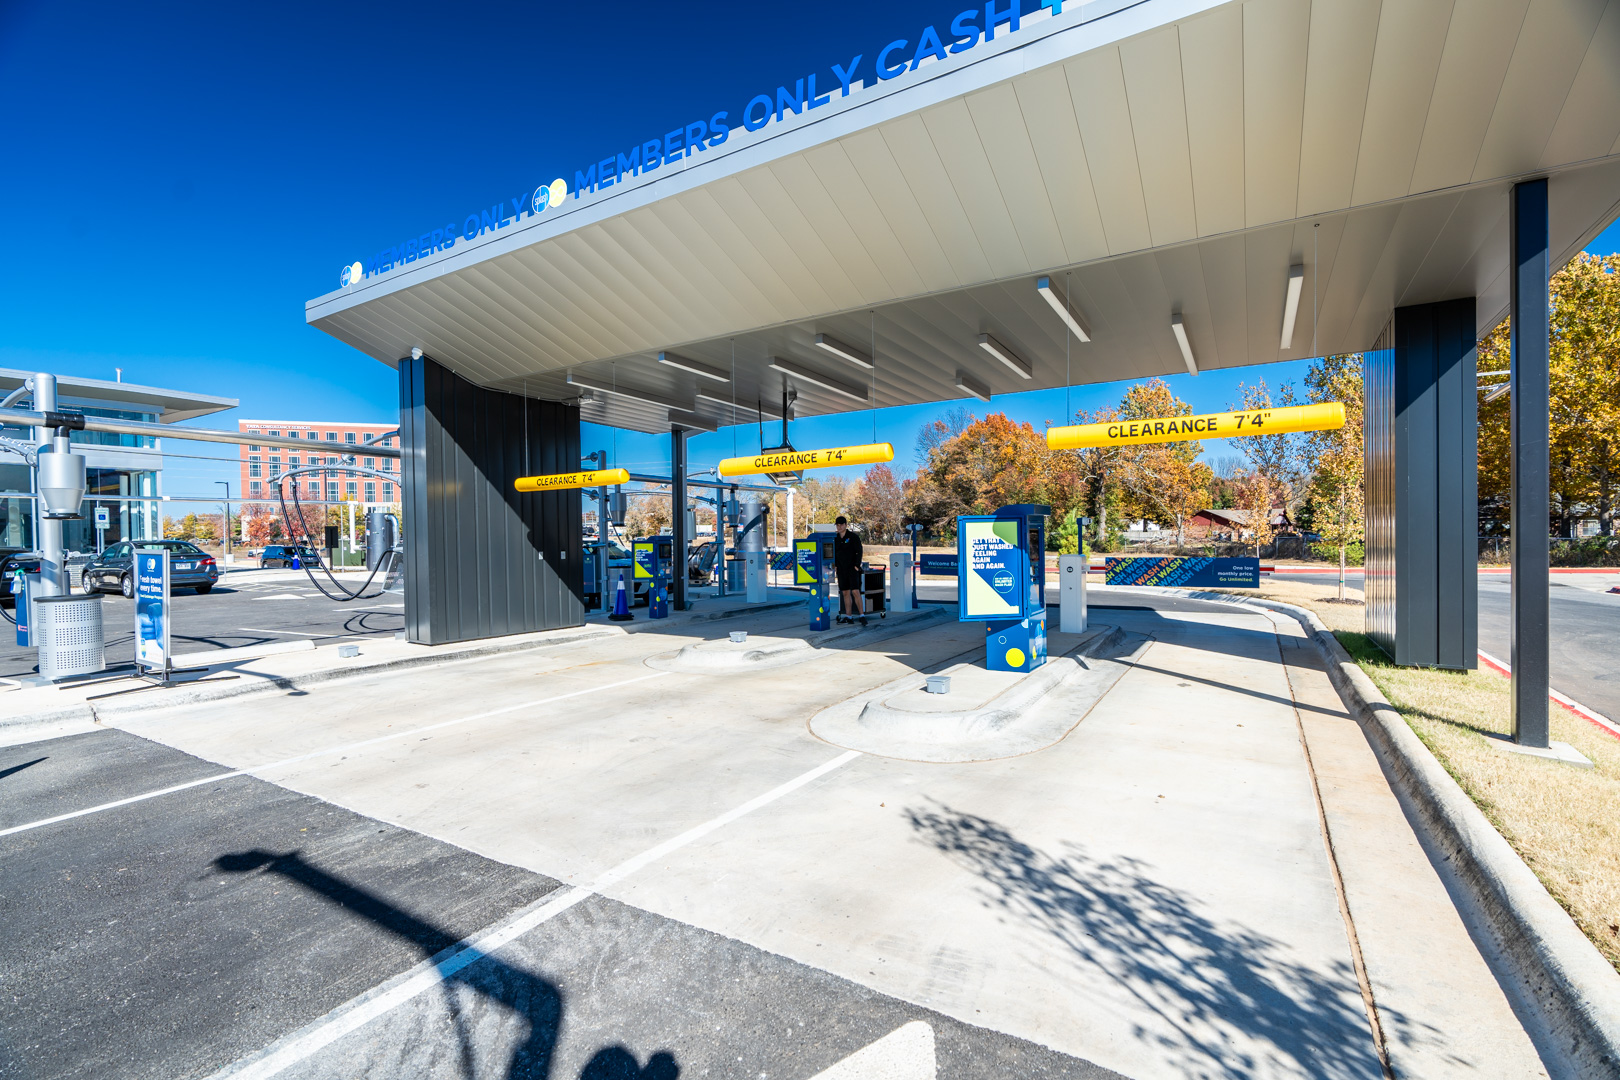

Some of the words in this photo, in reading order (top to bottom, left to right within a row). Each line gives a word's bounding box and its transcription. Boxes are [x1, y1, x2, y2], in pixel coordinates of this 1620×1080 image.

[875, 0, 1021, 80] CASH
[574, 110, 730, 200] MEMBERS
[743, 54, 863, 132] ONLY
[365, 223, 456, 279] MEMBERS
[463, 193, 528, 241] ONLY
[1108, 417, 1218, 439] CLEARANCE
[1234, 413, 1271, 429] 7'4"
[755, 452, 817, 468] CLEARANCE
[826, 449, 847, 461] 7'4"
[536, 475, 577, 487] CLEARANCE
[1157, 558, 1183, 578] WASH
[1192, 557, 1216, 572] WAS
[1135, 565, 1160, 585] WASH
